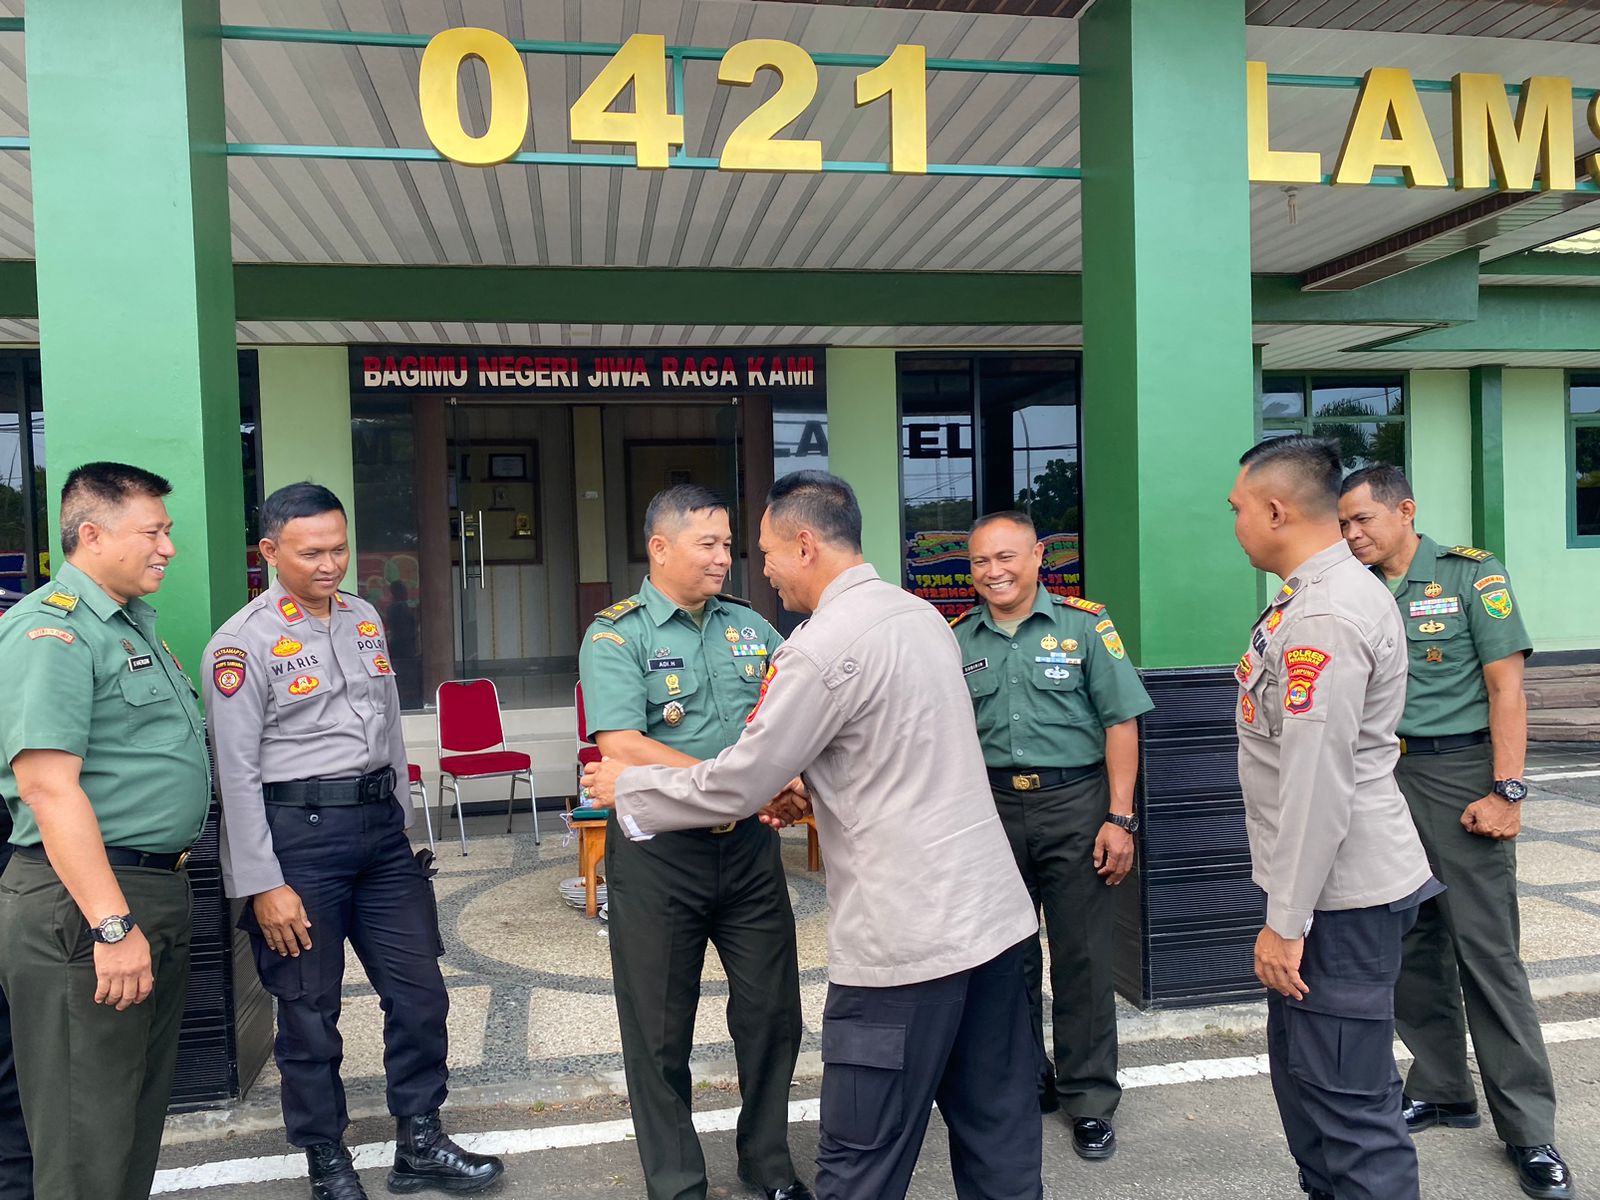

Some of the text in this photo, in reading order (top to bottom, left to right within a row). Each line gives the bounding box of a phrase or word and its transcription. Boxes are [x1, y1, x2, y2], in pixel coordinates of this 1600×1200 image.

[419, 27, 1600, 192] 0421 LAM
[363, 356, 815, 388] BAGIMU NEGERI JIWA RAGA KAMI
[271, 654, 319, 676] WARIS
[1287, 649, 1326, 662] POLRES
